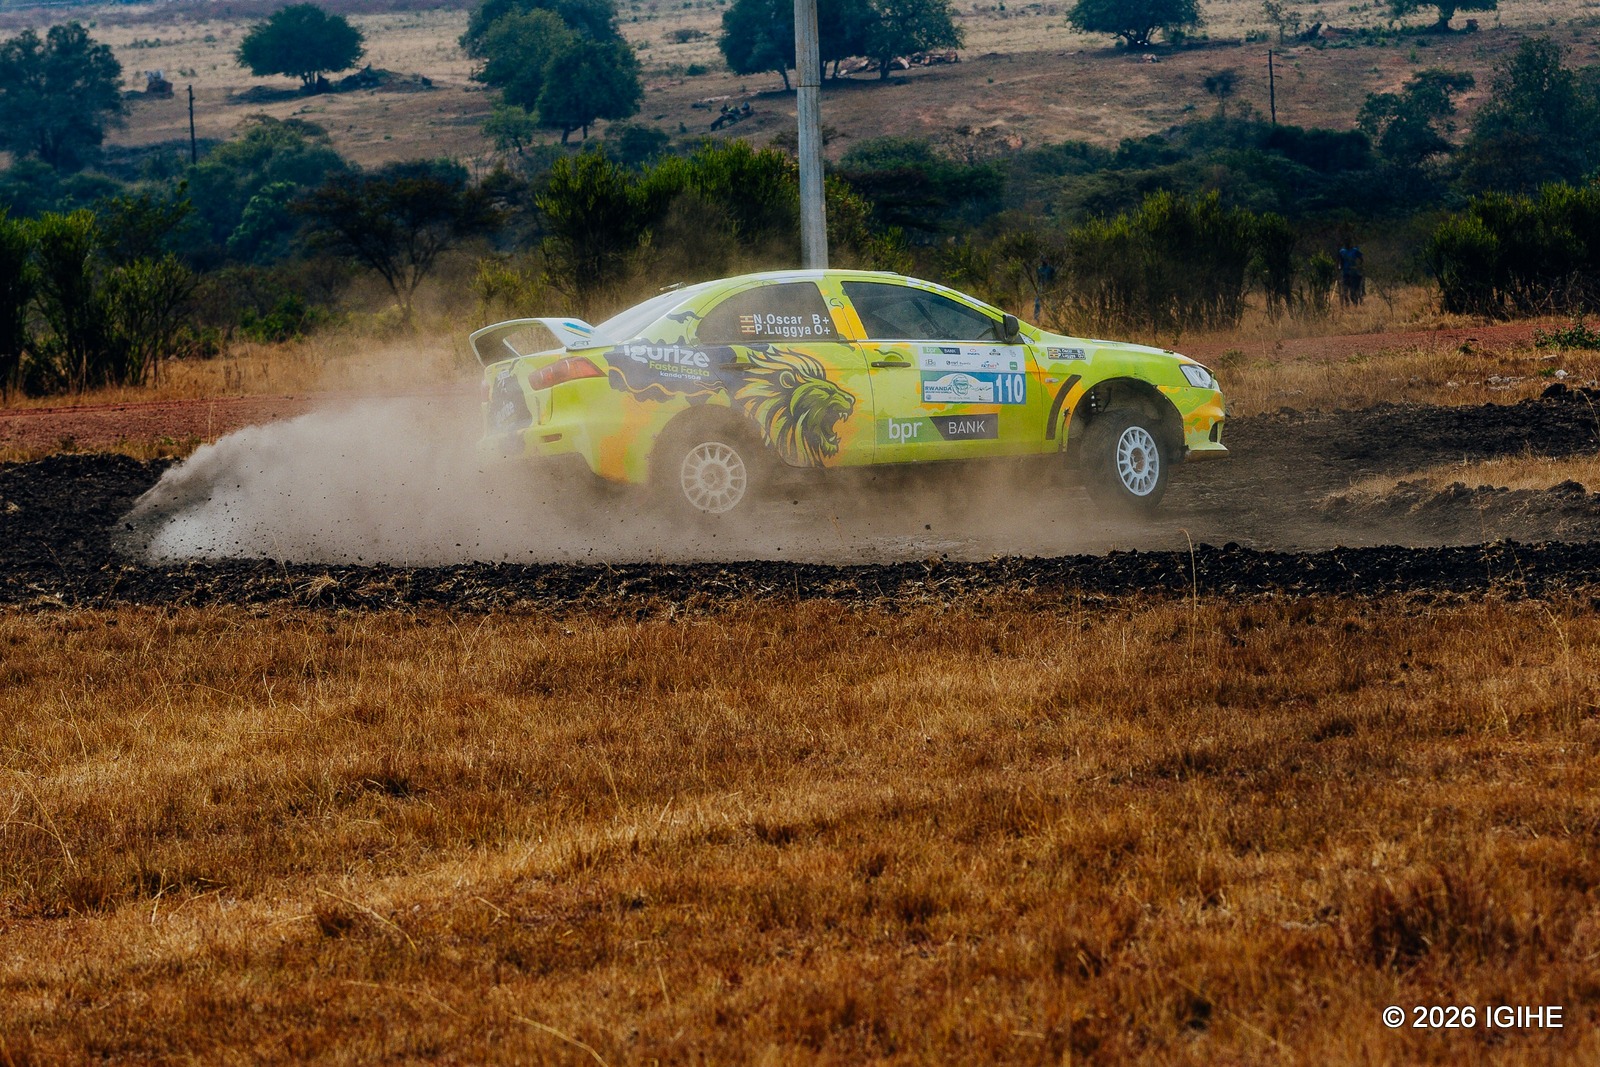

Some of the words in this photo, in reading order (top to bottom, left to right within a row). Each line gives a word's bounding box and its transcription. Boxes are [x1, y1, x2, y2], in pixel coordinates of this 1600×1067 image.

[812, 314, 829, 325] B+
[649, 361, 679, 373] Fasta
[680, 365, 710, 377] Fasta
[996, 374, 1024, 403] 110
[888, 418, 923, 444] bpr
[948, 420, 986, 435] BANK
